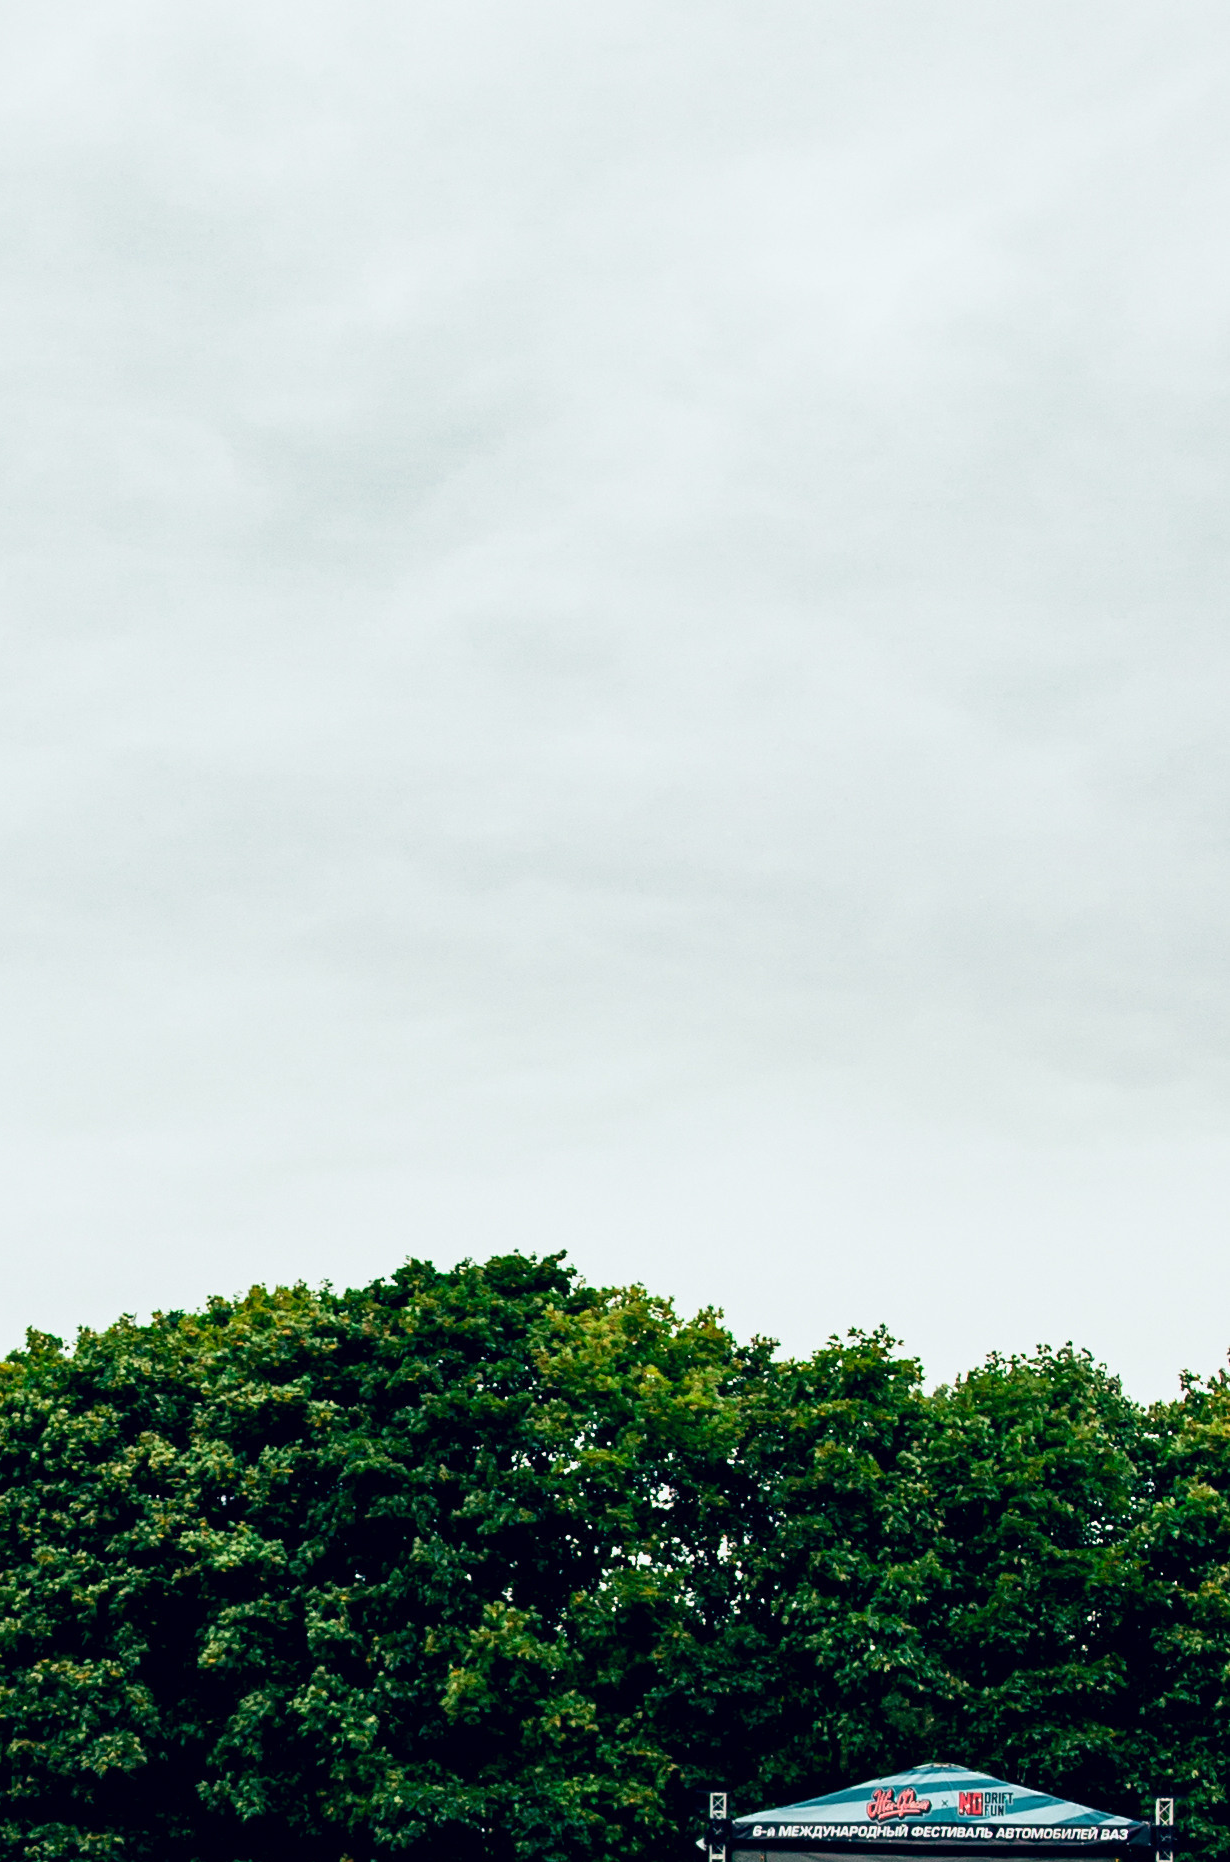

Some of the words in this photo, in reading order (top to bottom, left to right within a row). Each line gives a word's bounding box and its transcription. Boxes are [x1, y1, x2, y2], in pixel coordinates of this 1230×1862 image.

[959, 1791, 983, 1816] NO
[984, 1791, 1014, 1804] DRIFT
[984, 1804, 1005, 1816] FUN
[778, 1823, 909, 1839] МЕЖДУНАРОДНЫЙ
[911, 1825, 993, 1839] ФЕСТИВАЛЬ
[996, 1826, 1098, 1840] АВТОМОБИЛЕЙ
[1100, 1828, 1129, 1841] ВАЗ
